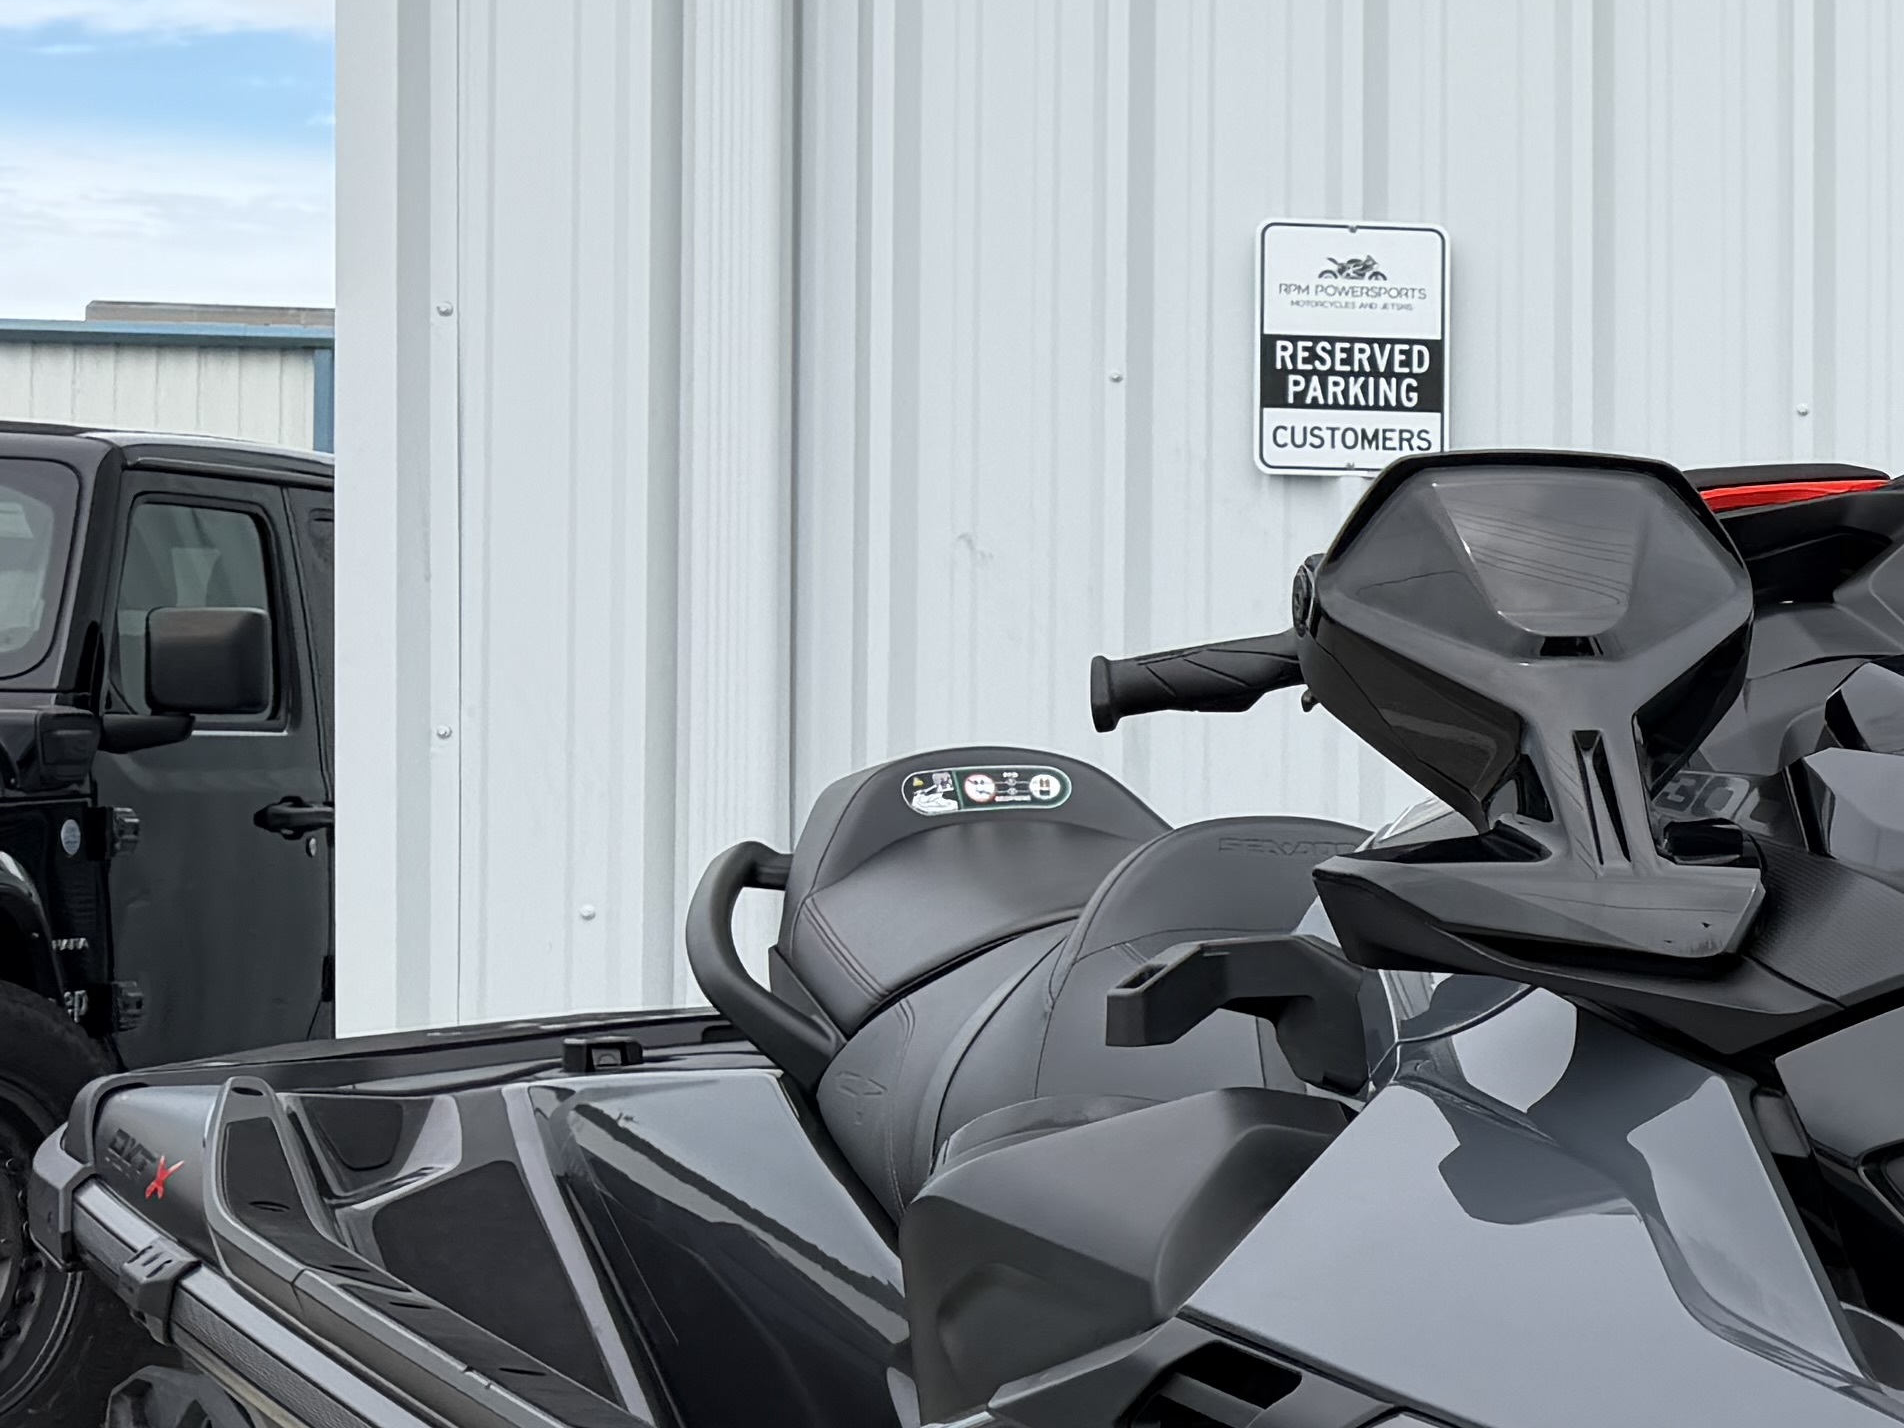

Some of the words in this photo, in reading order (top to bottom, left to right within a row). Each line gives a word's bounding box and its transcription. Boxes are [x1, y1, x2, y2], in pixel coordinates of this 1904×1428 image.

[1279, 283, 1310, 295] RPM
[1315, 284, 1427, 300] POWERSPORTS
[1275, 339, 1431, 374] RESERVED
[1287, 374, 1419, 408] PARKING
[1272, 425, 1432, 452] CUSTOMERS
